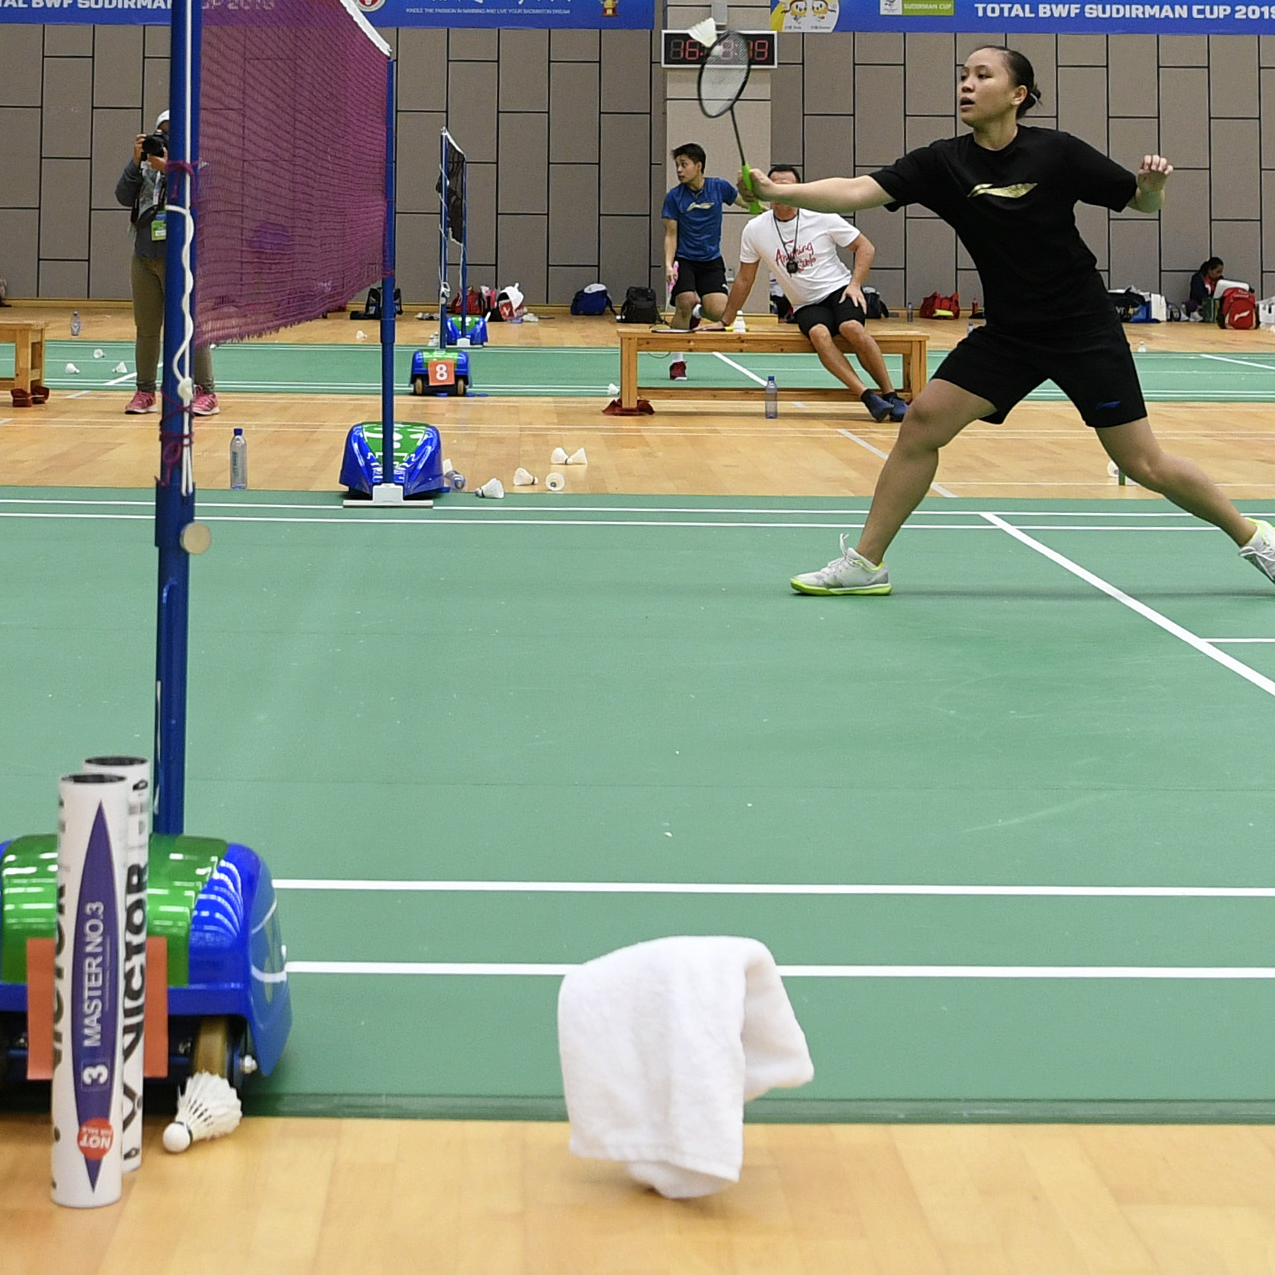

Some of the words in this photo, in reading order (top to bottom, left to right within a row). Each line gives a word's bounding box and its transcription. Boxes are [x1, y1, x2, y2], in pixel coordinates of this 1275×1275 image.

[974, 3, 1035, 18] TOTAL
[1038, 4, 1081, 18] BWF
[1084, 4, 1188, 19] SUDIRMAN
[1192, 4, 1231, 19] CUP
[436, 363, 448, 381] 8
[84, 900, 105, 953] NO.3
[83, 955, 103, 1047] MASTER
[83, 1063, 109, 1086] 3
[79, 1133, 112, 1149] NOT
